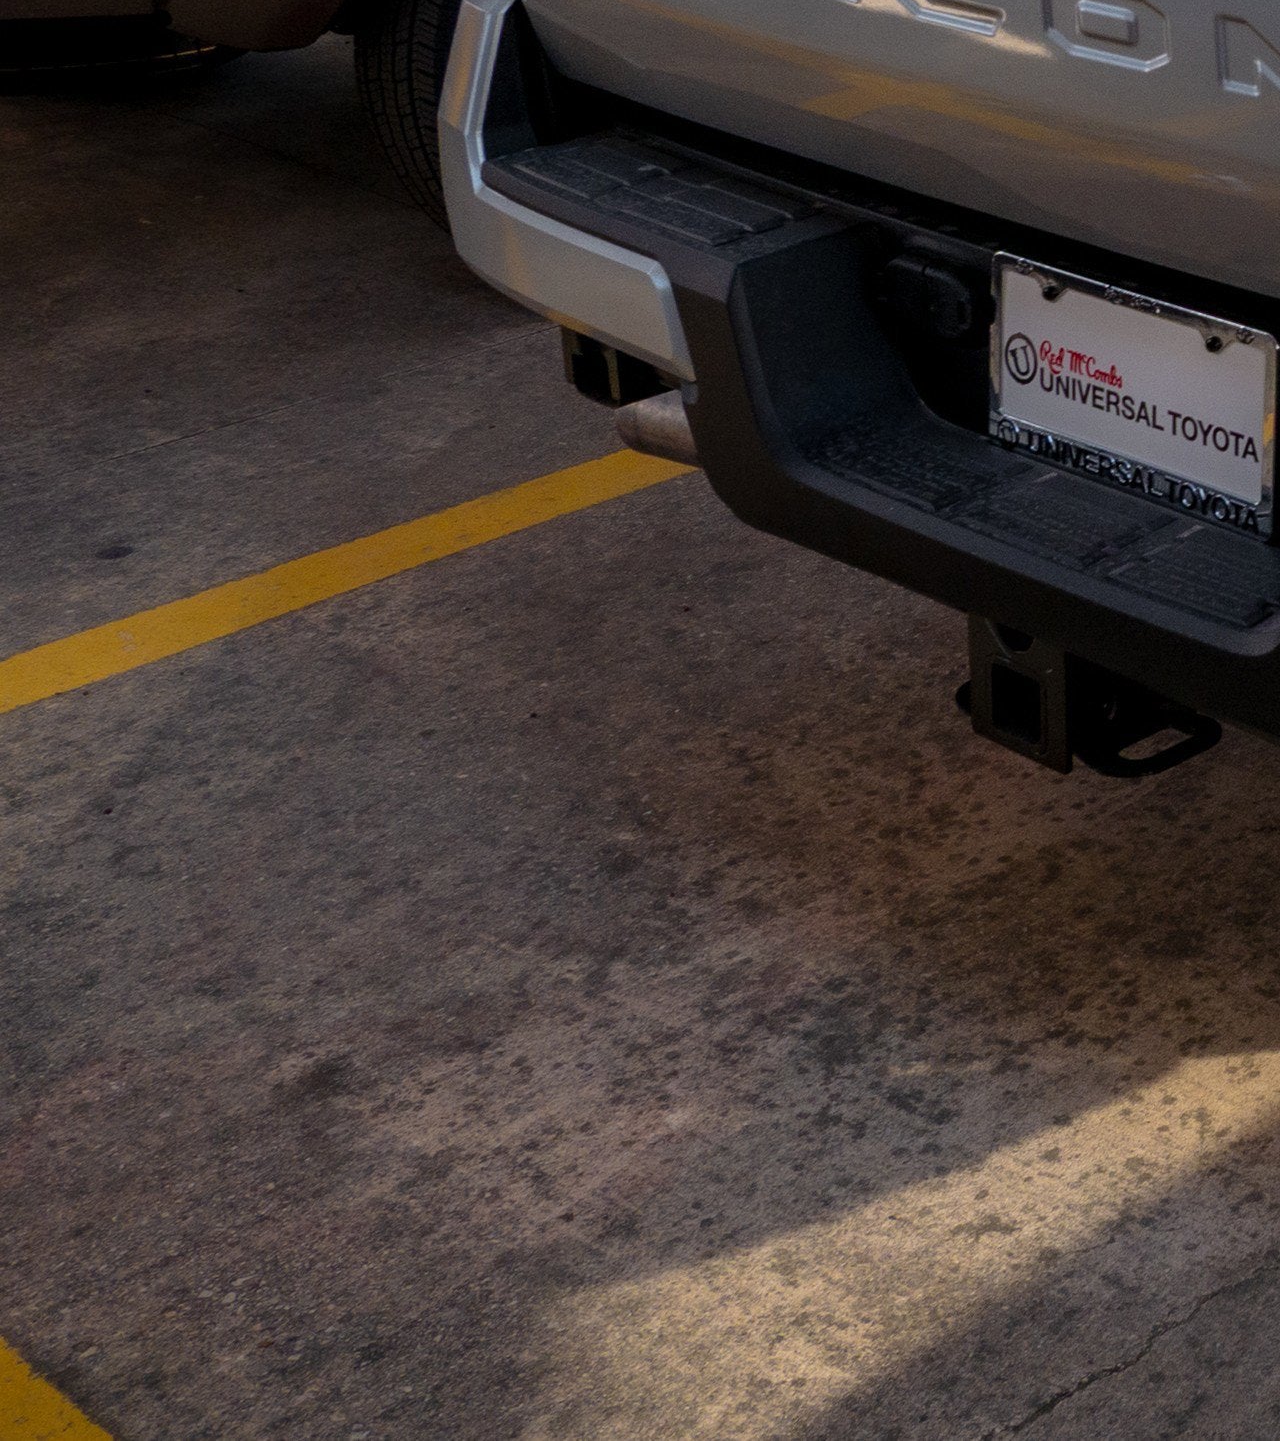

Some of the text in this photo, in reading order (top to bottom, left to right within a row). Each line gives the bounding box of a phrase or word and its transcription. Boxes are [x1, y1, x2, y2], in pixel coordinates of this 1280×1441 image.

[1040, 340, 1064, 376] Red
[1040, 368, 1260, 463] UNIVERSAL TOYOTA
[1022, 430, 1164, 498] UNIVERSAL
[1165, 478, 1260, 535] TOYOTA
